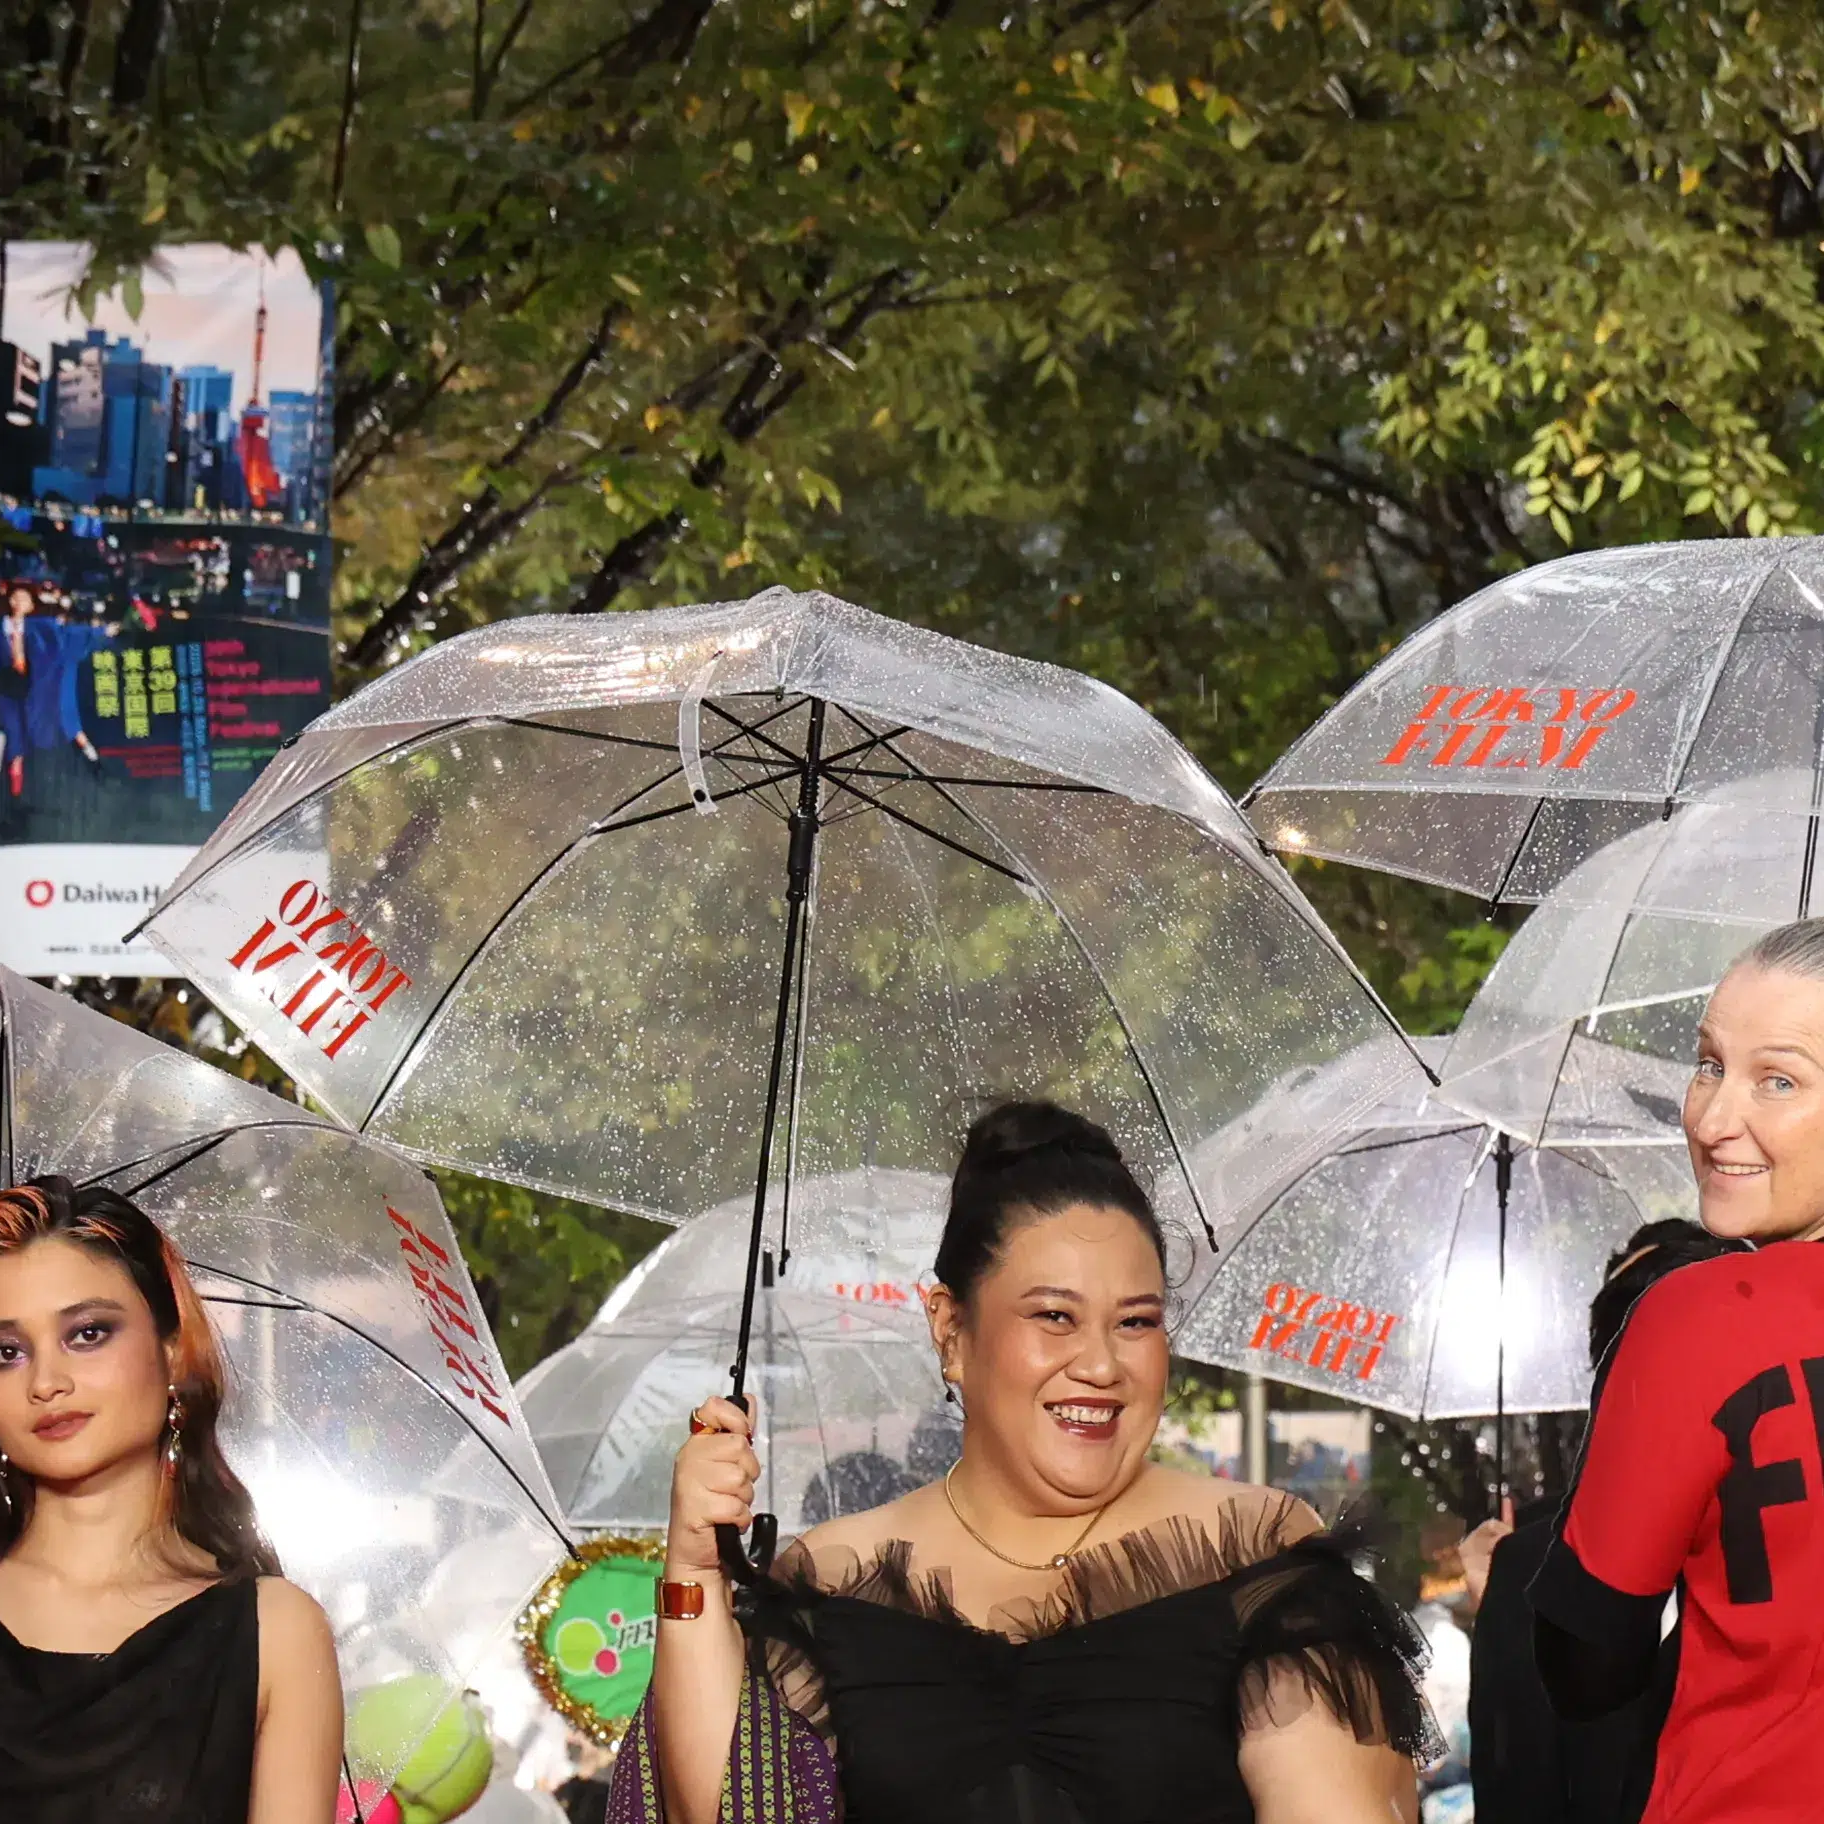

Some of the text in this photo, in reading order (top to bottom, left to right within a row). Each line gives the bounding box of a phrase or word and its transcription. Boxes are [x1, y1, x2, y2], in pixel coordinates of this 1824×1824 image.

[1416, 685, 1638, 722] TOKYO
[1377, 723, 1610, 769] FILM
[63, 884, 138, 904] Daiwa
[828, 1282, 931, 1306] TOK
